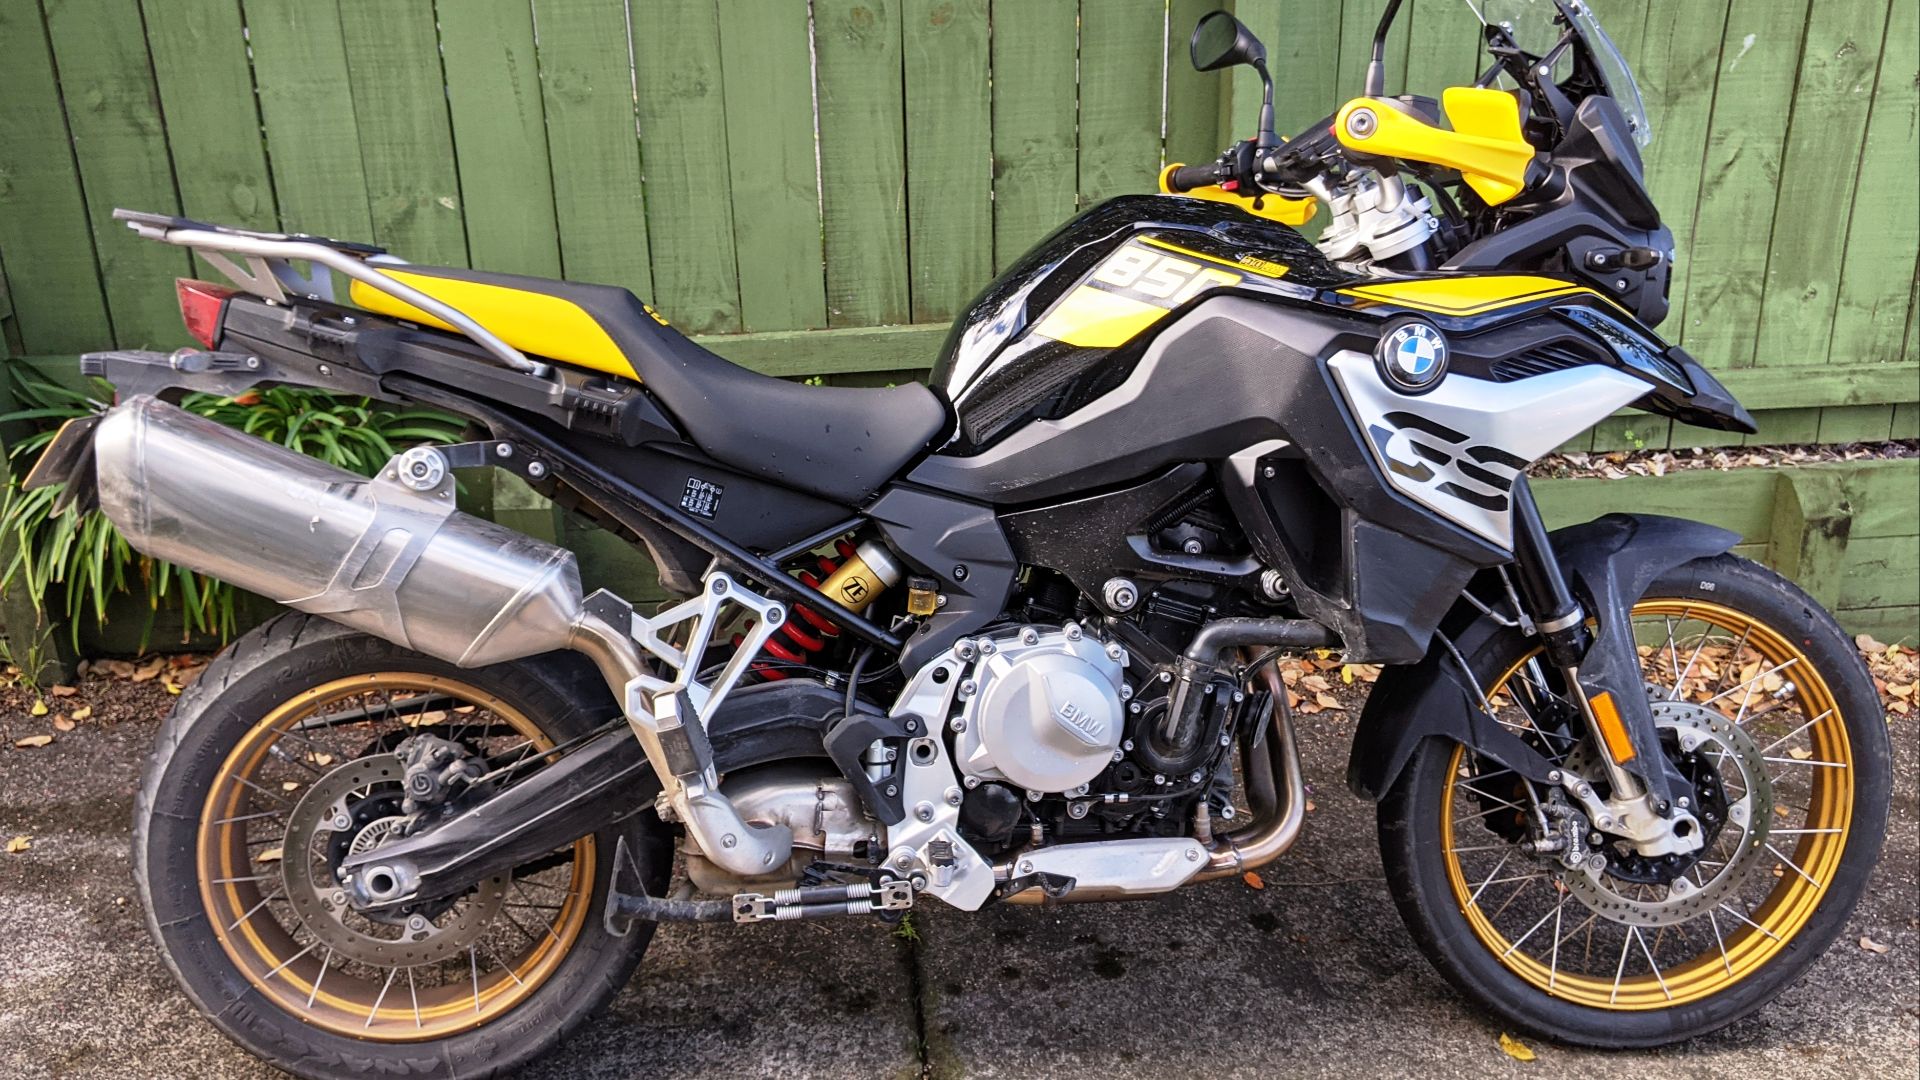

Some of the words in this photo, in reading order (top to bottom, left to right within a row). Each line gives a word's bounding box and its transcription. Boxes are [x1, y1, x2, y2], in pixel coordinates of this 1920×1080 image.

[1394, 325, 1443, 350] BMW
[1368, 411, 1532, 512] GS
[841, 576, 869, 603] ZF
[1060, 700, 1105, 737] BMW
